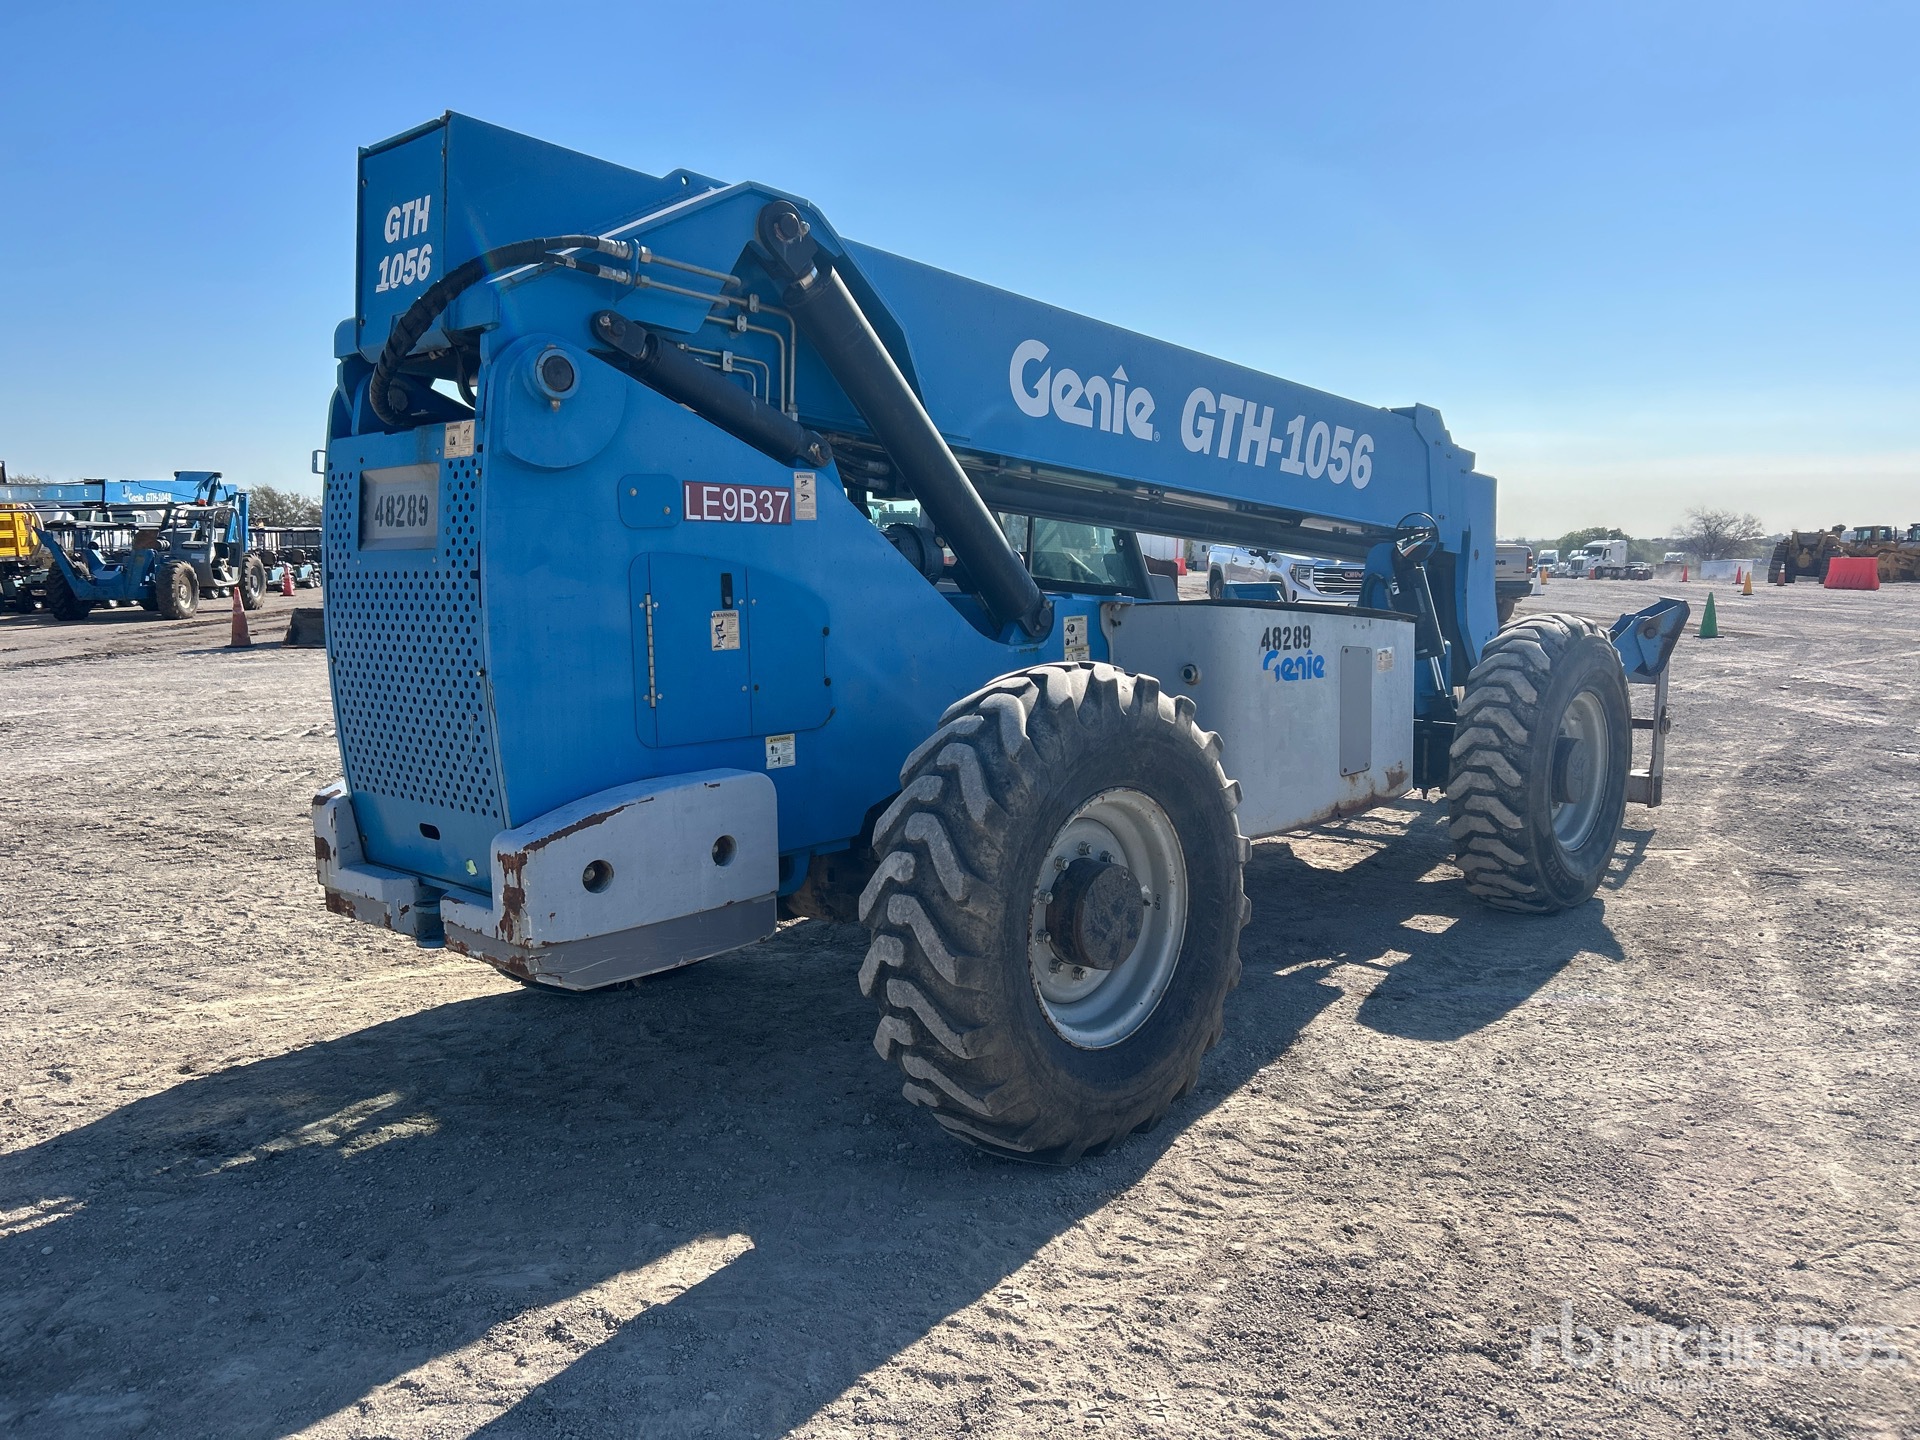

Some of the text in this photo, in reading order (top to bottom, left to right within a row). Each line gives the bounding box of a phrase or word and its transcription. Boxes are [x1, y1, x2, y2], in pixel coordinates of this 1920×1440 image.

[384, 194, 431, 244] GTH
[375, 243, 433, 293] 1056
[1009, 338, 1375, 490] Genie GTH-1056
[374, 494, 430, 529] 48289
[685, 484, 789, 523] LE9B37
[1260, 624, 1312, 651] 48289
[1262, 648, 1326, 682] Genie
